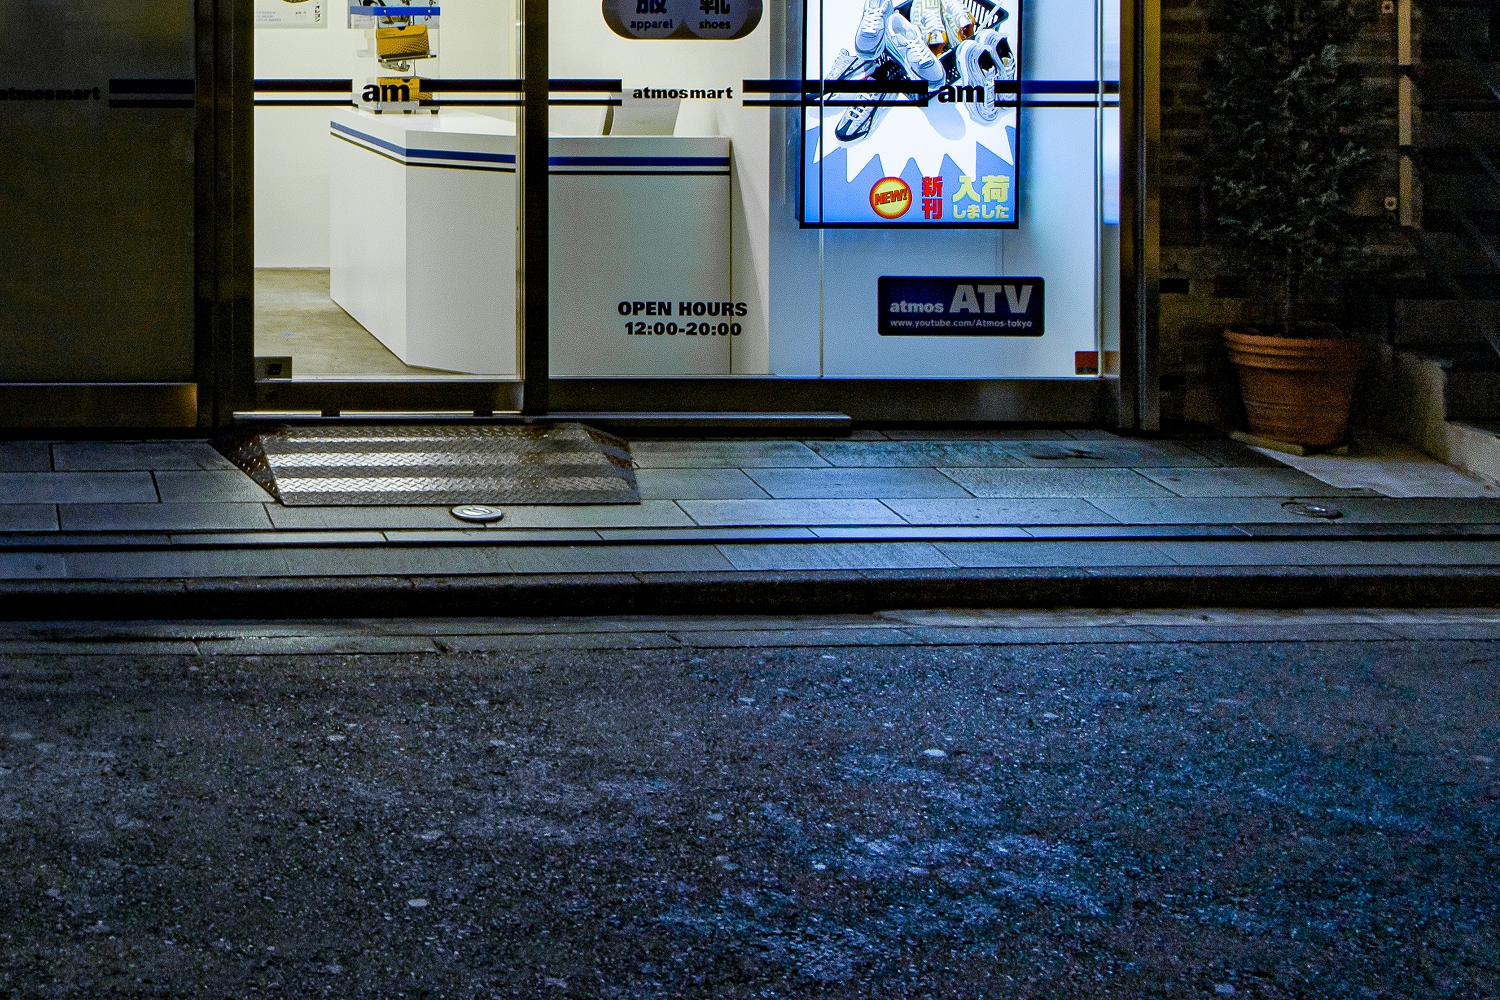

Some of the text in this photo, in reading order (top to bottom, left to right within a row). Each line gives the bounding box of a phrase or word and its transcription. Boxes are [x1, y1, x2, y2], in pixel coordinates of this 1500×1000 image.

[630, 19, 673, 31] apparel
[699, 19, 731, 30] shoes
[361, 83, 411, 103] am
[632, 86, 733, 99] atmosmart
[937, 84, 985, 104] am
[952, 175, 1010, 203] 入荷
[921, 175, 943, 220] 新刊
[952, 205, 1010, 219] しました
[889, 284, 1034, 314] atmos ATV
[617, 301, 748, 316] OPEN HOURS
[624, 321, 742, 336] 12:00-20:00
